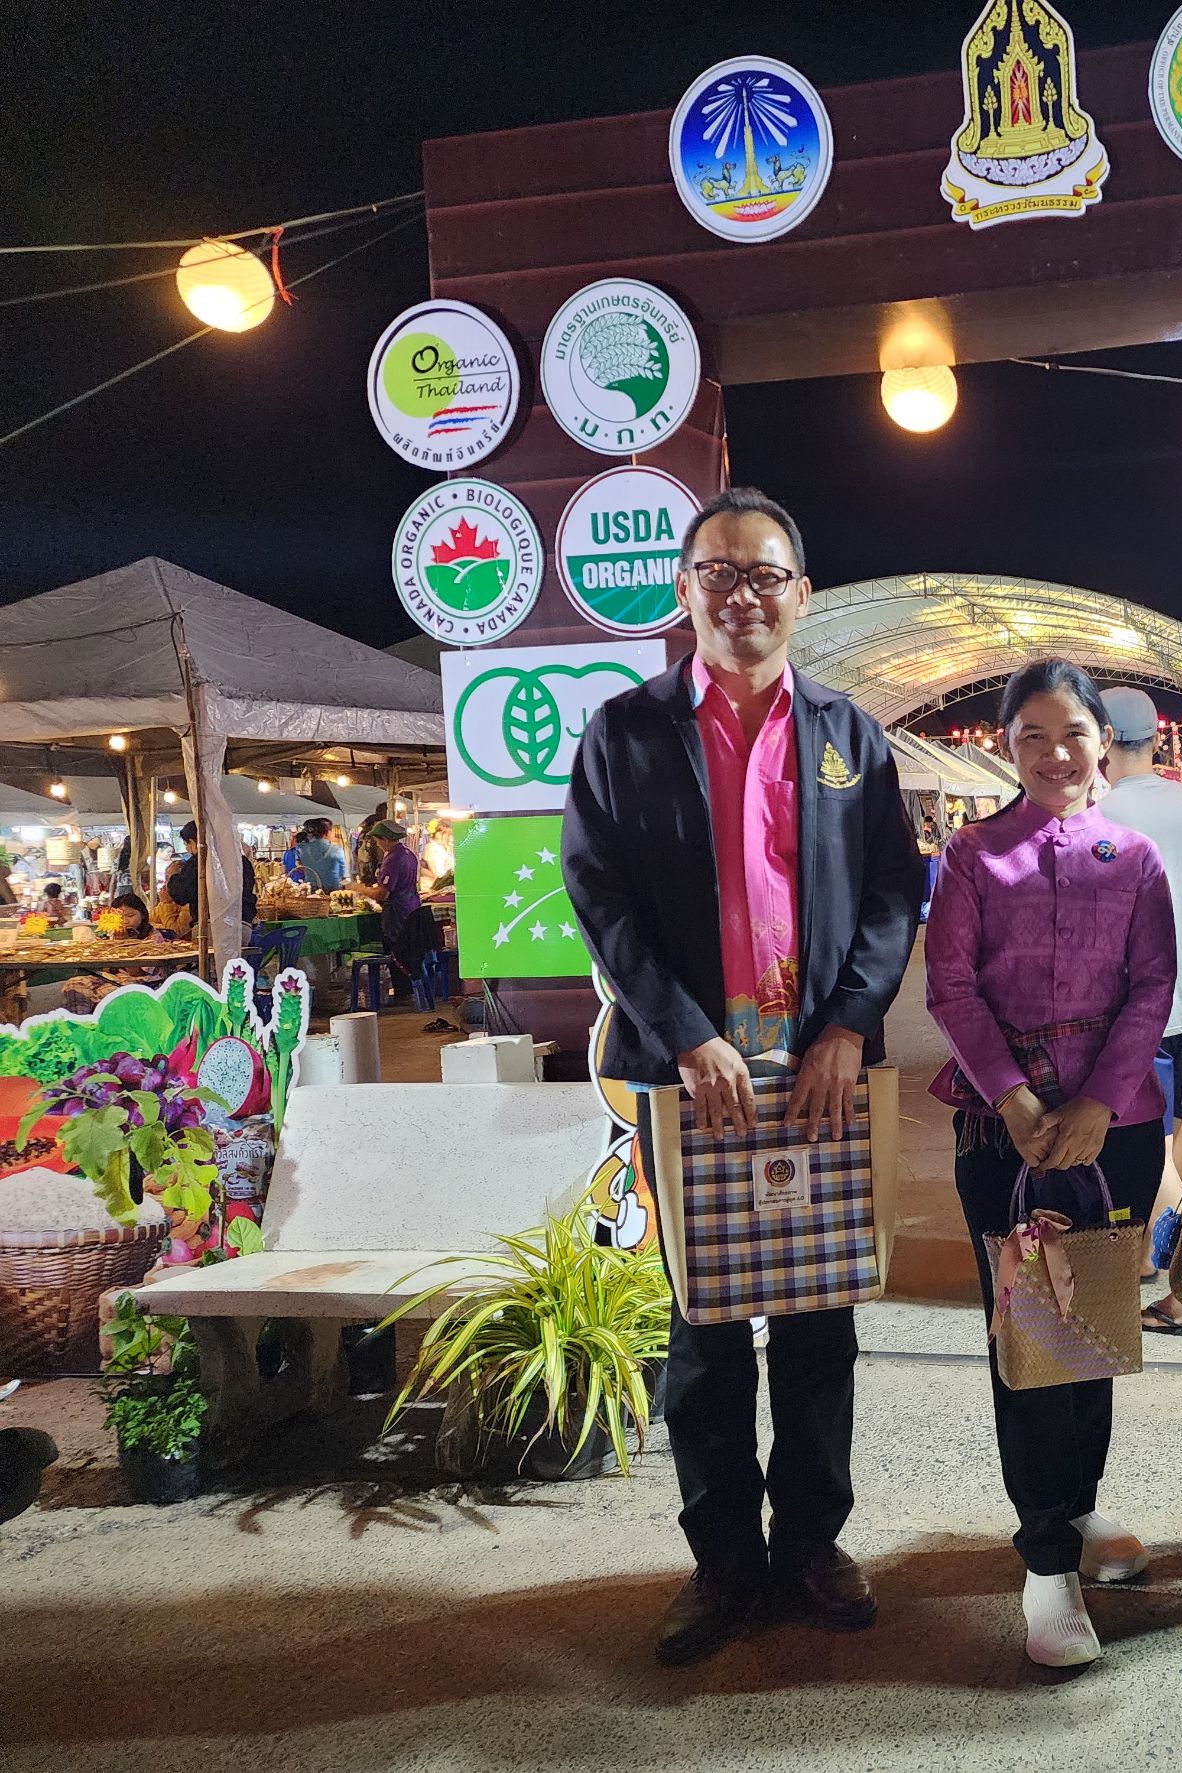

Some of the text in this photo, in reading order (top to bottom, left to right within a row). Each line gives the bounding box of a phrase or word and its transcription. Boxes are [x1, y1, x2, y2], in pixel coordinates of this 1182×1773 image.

[554, 295, 685, 360] มาตรฐานเกษตรอินทรีย์
[411, 342, 501, 376] Organic
[416, 377, 506, 399] Thailand
[590, 507, 675, 545] USDA
[400, 497, 455, 634] CANADA ORGANIC
[466, 488, 533, 636] BIOLOGIQUE CANADA
